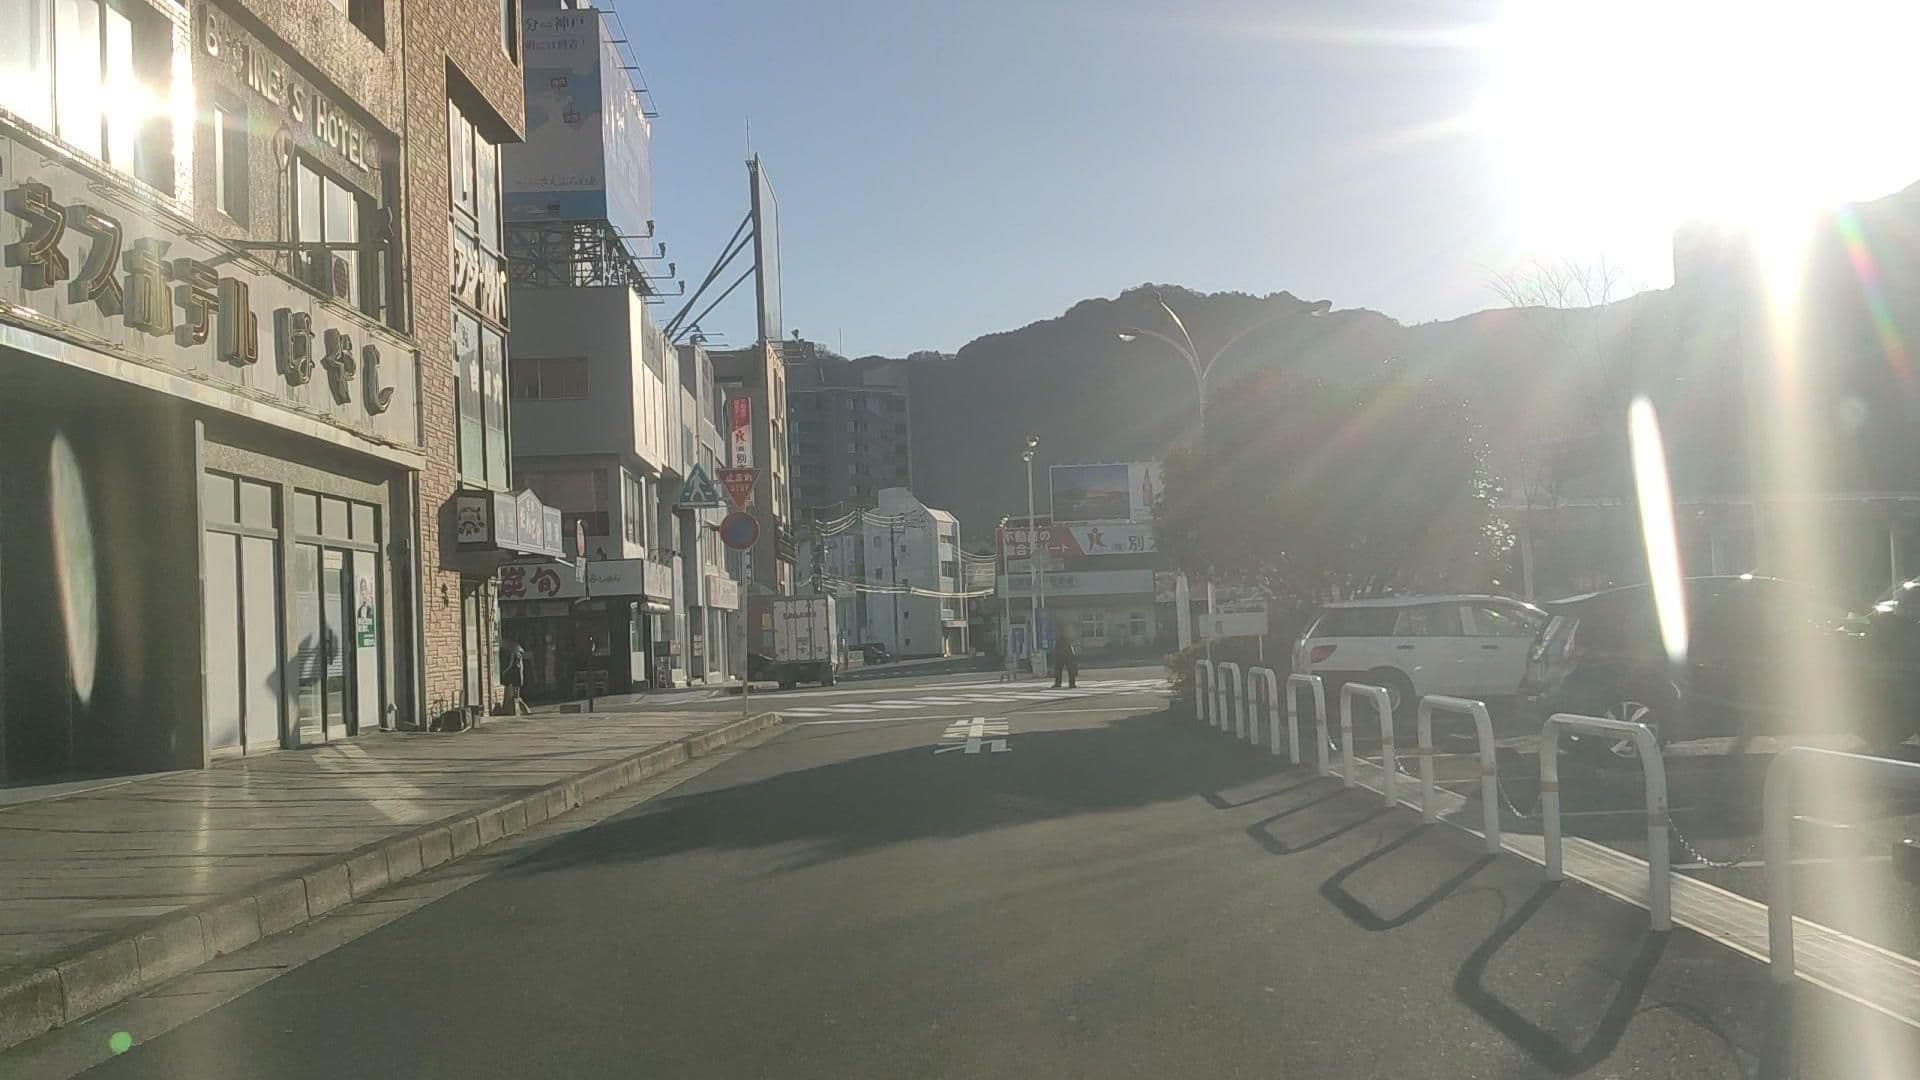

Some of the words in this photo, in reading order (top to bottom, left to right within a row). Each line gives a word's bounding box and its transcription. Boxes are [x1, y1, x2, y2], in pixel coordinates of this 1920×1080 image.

[313, 94, 369, 172] HOTEL
[273, 307, 394, 416] はやし
